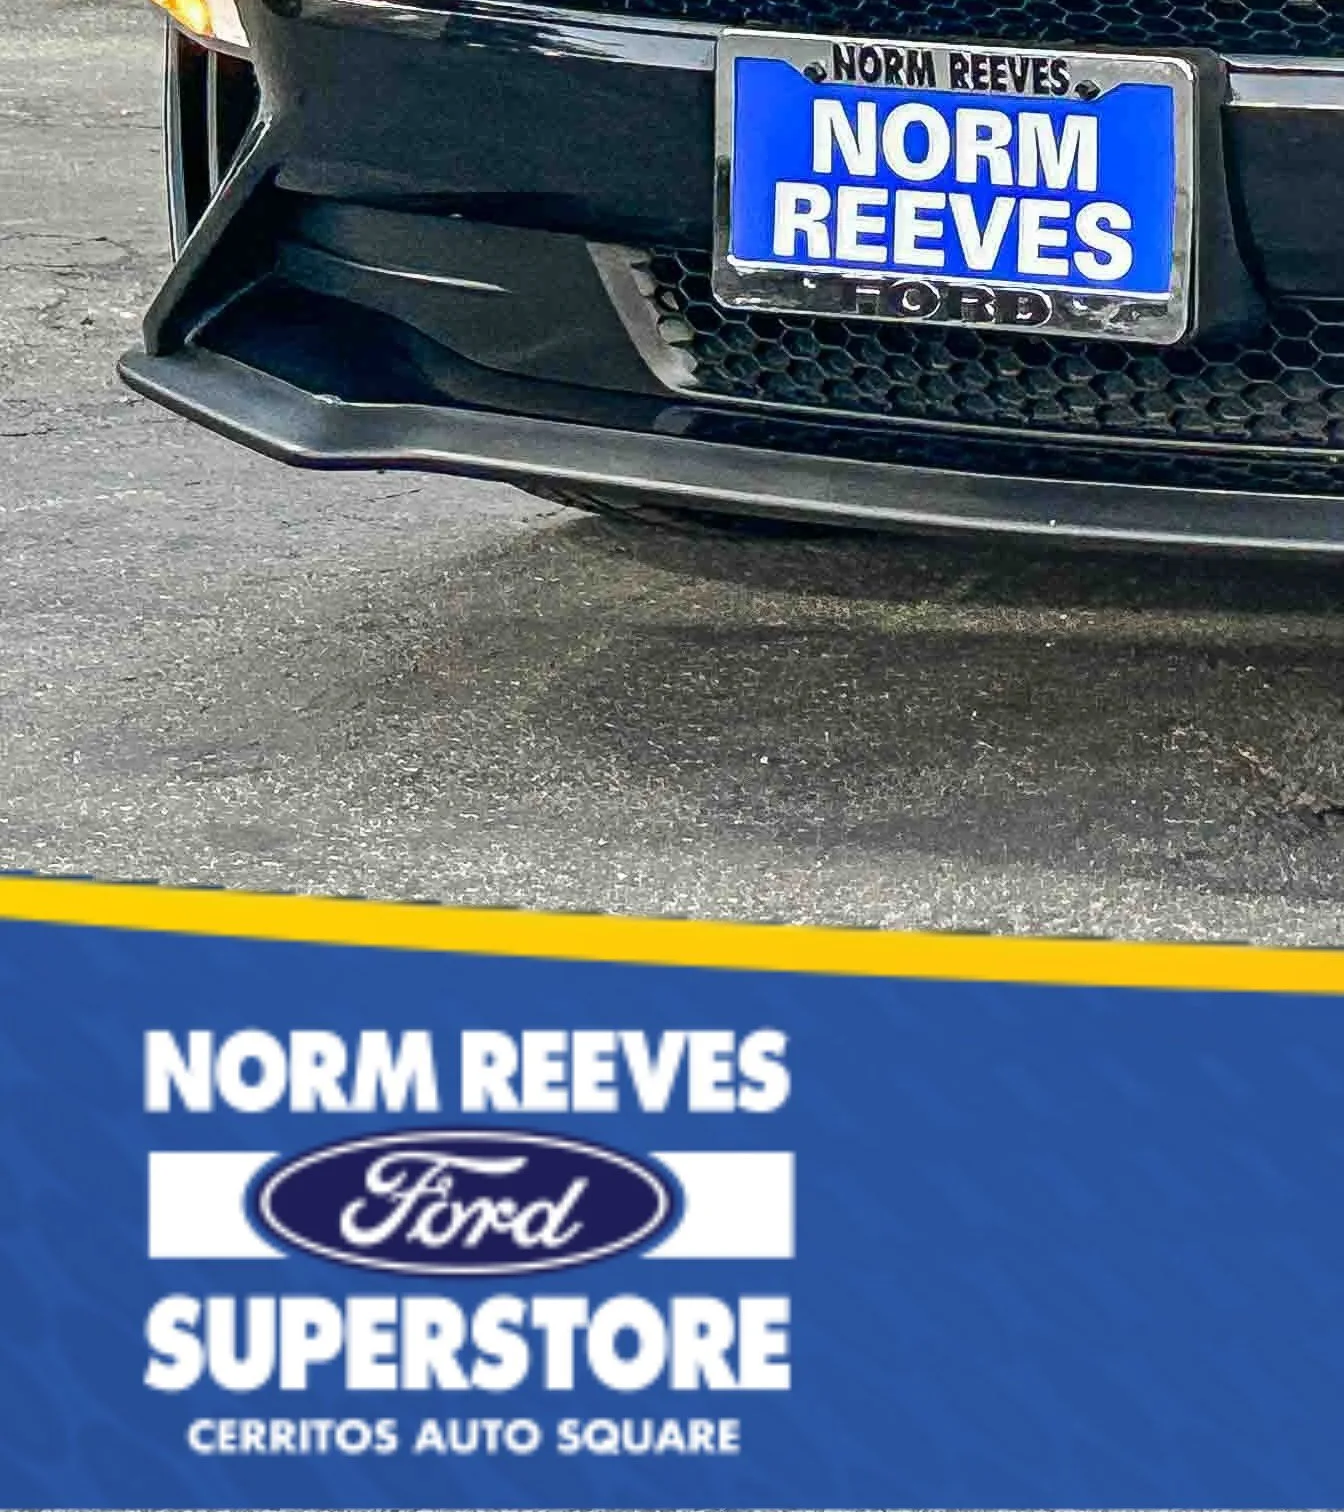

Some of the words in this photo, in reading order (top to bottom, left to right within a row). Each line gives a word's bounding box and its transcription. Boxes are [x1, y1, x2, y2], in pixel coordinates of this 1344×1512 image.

[831, 43, 936, 88] NORM
[949, 53, 1071, 96] REEVES
[811, 98, 1098, 192] NORM
[772, 181, 1134, 281] REEVES
[855, 279, 1054, 328] FORD
